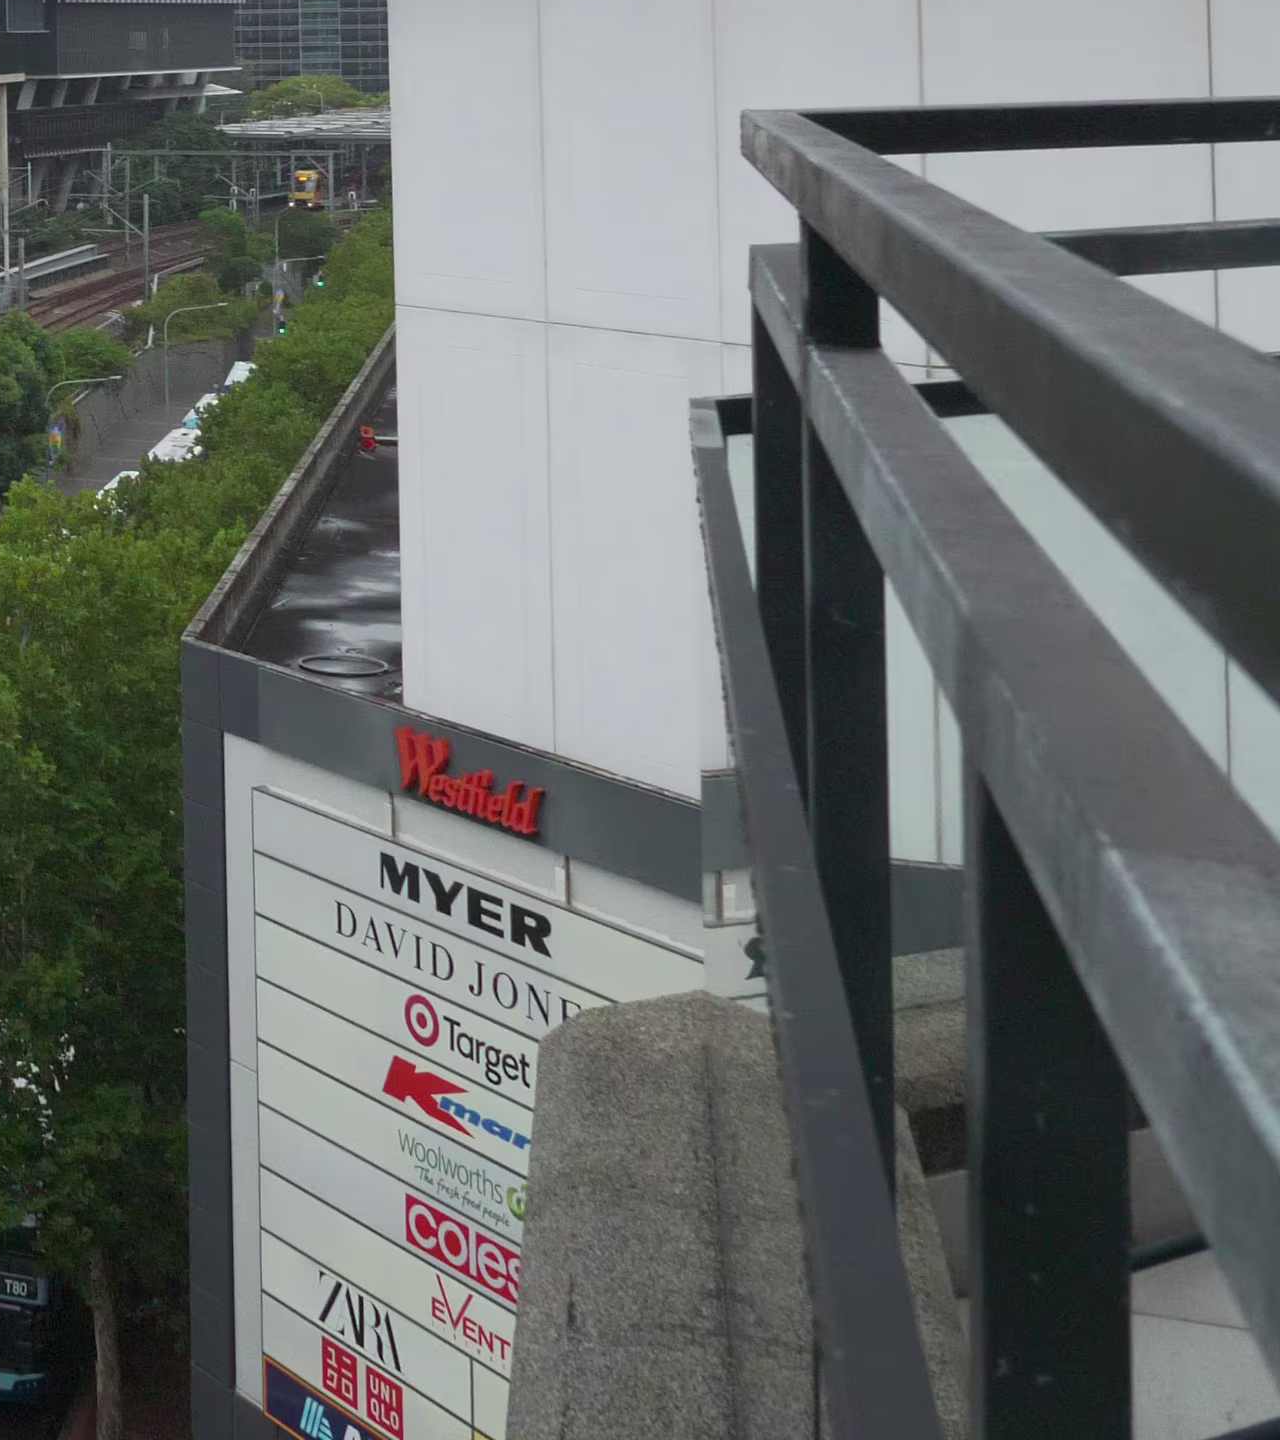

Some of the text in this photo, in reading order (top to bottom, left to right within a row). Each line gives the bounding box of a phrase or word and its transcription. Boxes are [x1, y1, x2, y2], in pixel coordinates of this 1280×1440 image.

[394, 726, 544, 835] Westfield
[334, 899, 454, 981] DAVID
[380, 851, 552, 958] MYER
[443, 1015, 531, 1089] Target
[382, 1055, 531, 1150] Kmar
[398, 1129, 503, 1205] Woolworths
[414, 1165, 510, 1227] The fresh food people
[4, 1279, 27, 1296] T80
[318, 1270, 405, 1375] ZARA
[431, 1273, 511, 1360] EVENT
